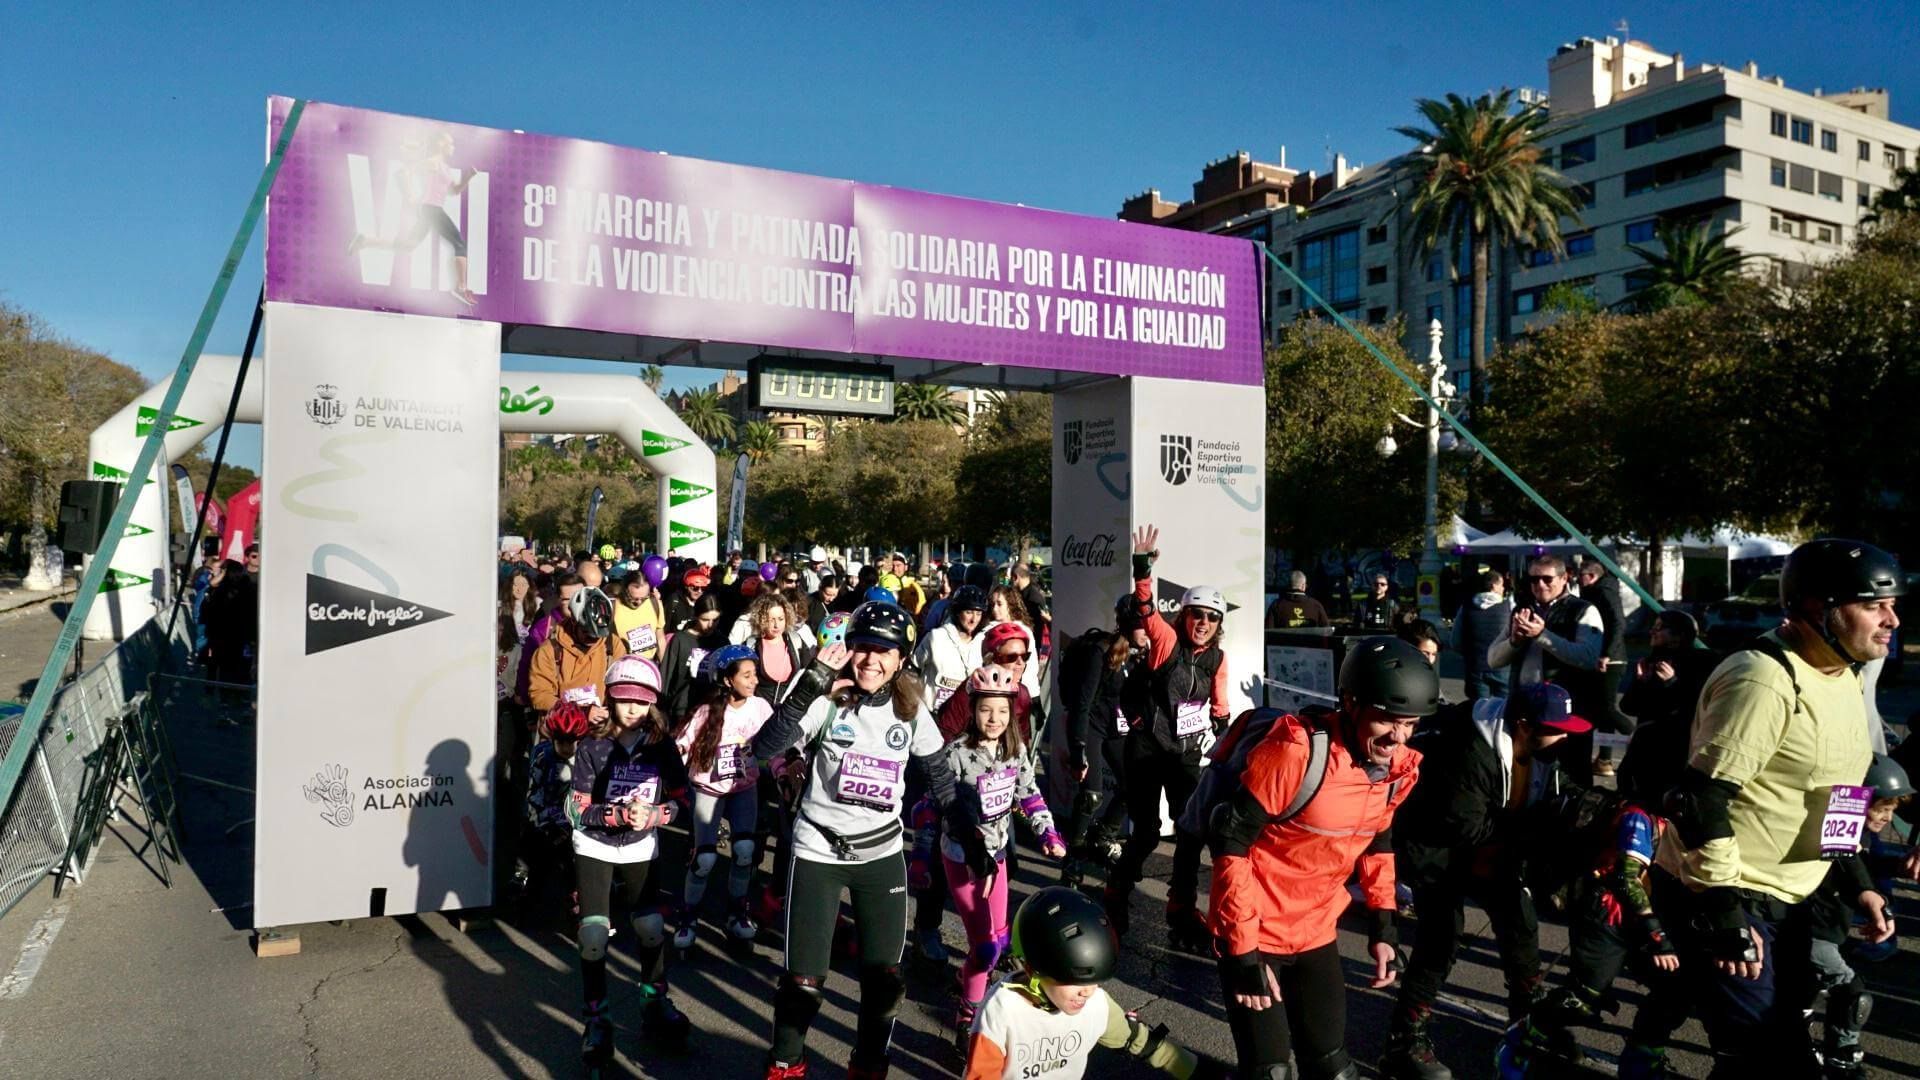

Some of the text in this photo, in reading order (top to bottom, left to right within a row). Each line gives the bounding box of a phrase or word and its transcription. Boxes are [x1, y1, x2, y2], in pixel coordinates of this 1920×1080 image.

[523, 183, 1226, 309] 8ª MARCHA Y PATINADA SOLIDARIA POR LA ELIMINACIÓN
[523, 236, 1226, 351] DE LA VIOLENCIA CONTRA LAS MUJERES Y POR LA IGUALDAD
[355, 396, 464, 416] AJUNTAMENT
[354, 415, 377, 428] DE
[1197, 439, 1241, 451] Fundació
[1197, 451, 1243, 463] Esportiva
[1197, 463, 1244, 475] Municipal
[308, 600, 424, 627] El Corte Inglés
[721, 758, 743, 770] 202
[363, 773, 455, 790] Asociación
[610, 783, 652, 799] 2024
[842, 780, 893, 800] 2024
[363, 790, 455, 811] ALANNA
[1823, 819, 1859, 839] 2024
[1015, 1029, 1082, 1067] DINO
[1022, 1058, 1068, 1080] SQUAD
